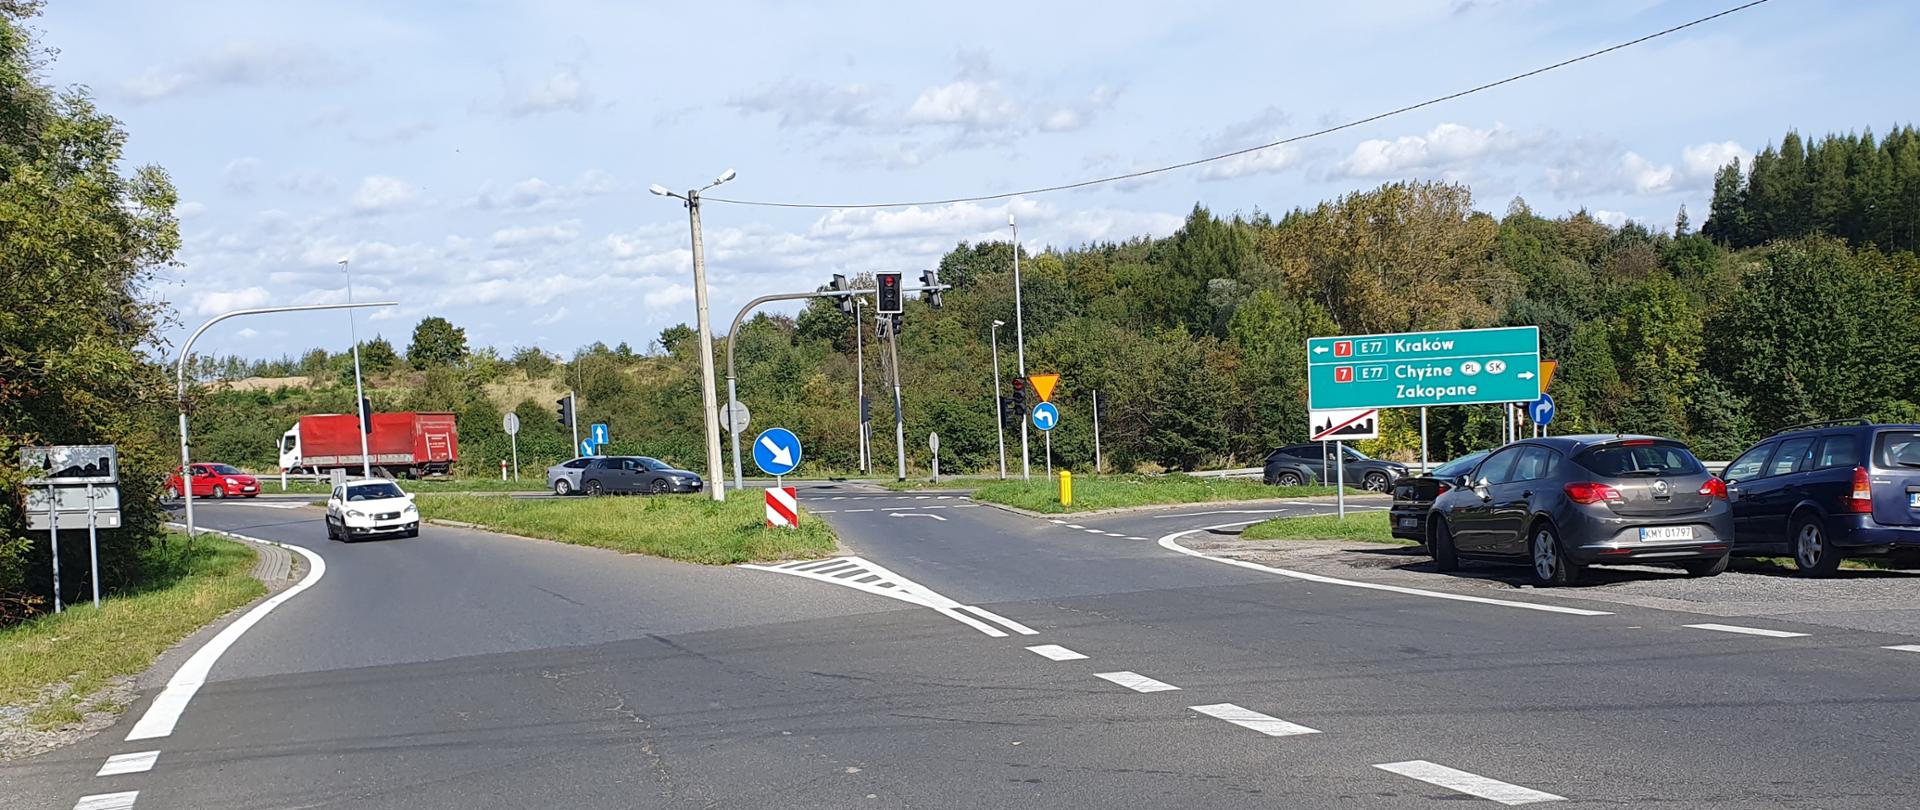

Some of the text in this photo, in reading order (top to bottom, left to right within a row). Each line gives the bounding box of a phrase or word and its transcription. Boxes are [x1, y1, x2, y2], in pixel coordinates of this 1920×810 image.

[1339, 343, 1347, 355] 7
[1395, 337, 1454, 353] Kraków
[1340, 369, 1348, 380] 7
[1465, 364, 1476, 372] PL
[1489, 362, 1502, 372] SK
[1396, 384, 1477, 400] Zakopane
[1646, 527, 1691, 538] KMY 01797
